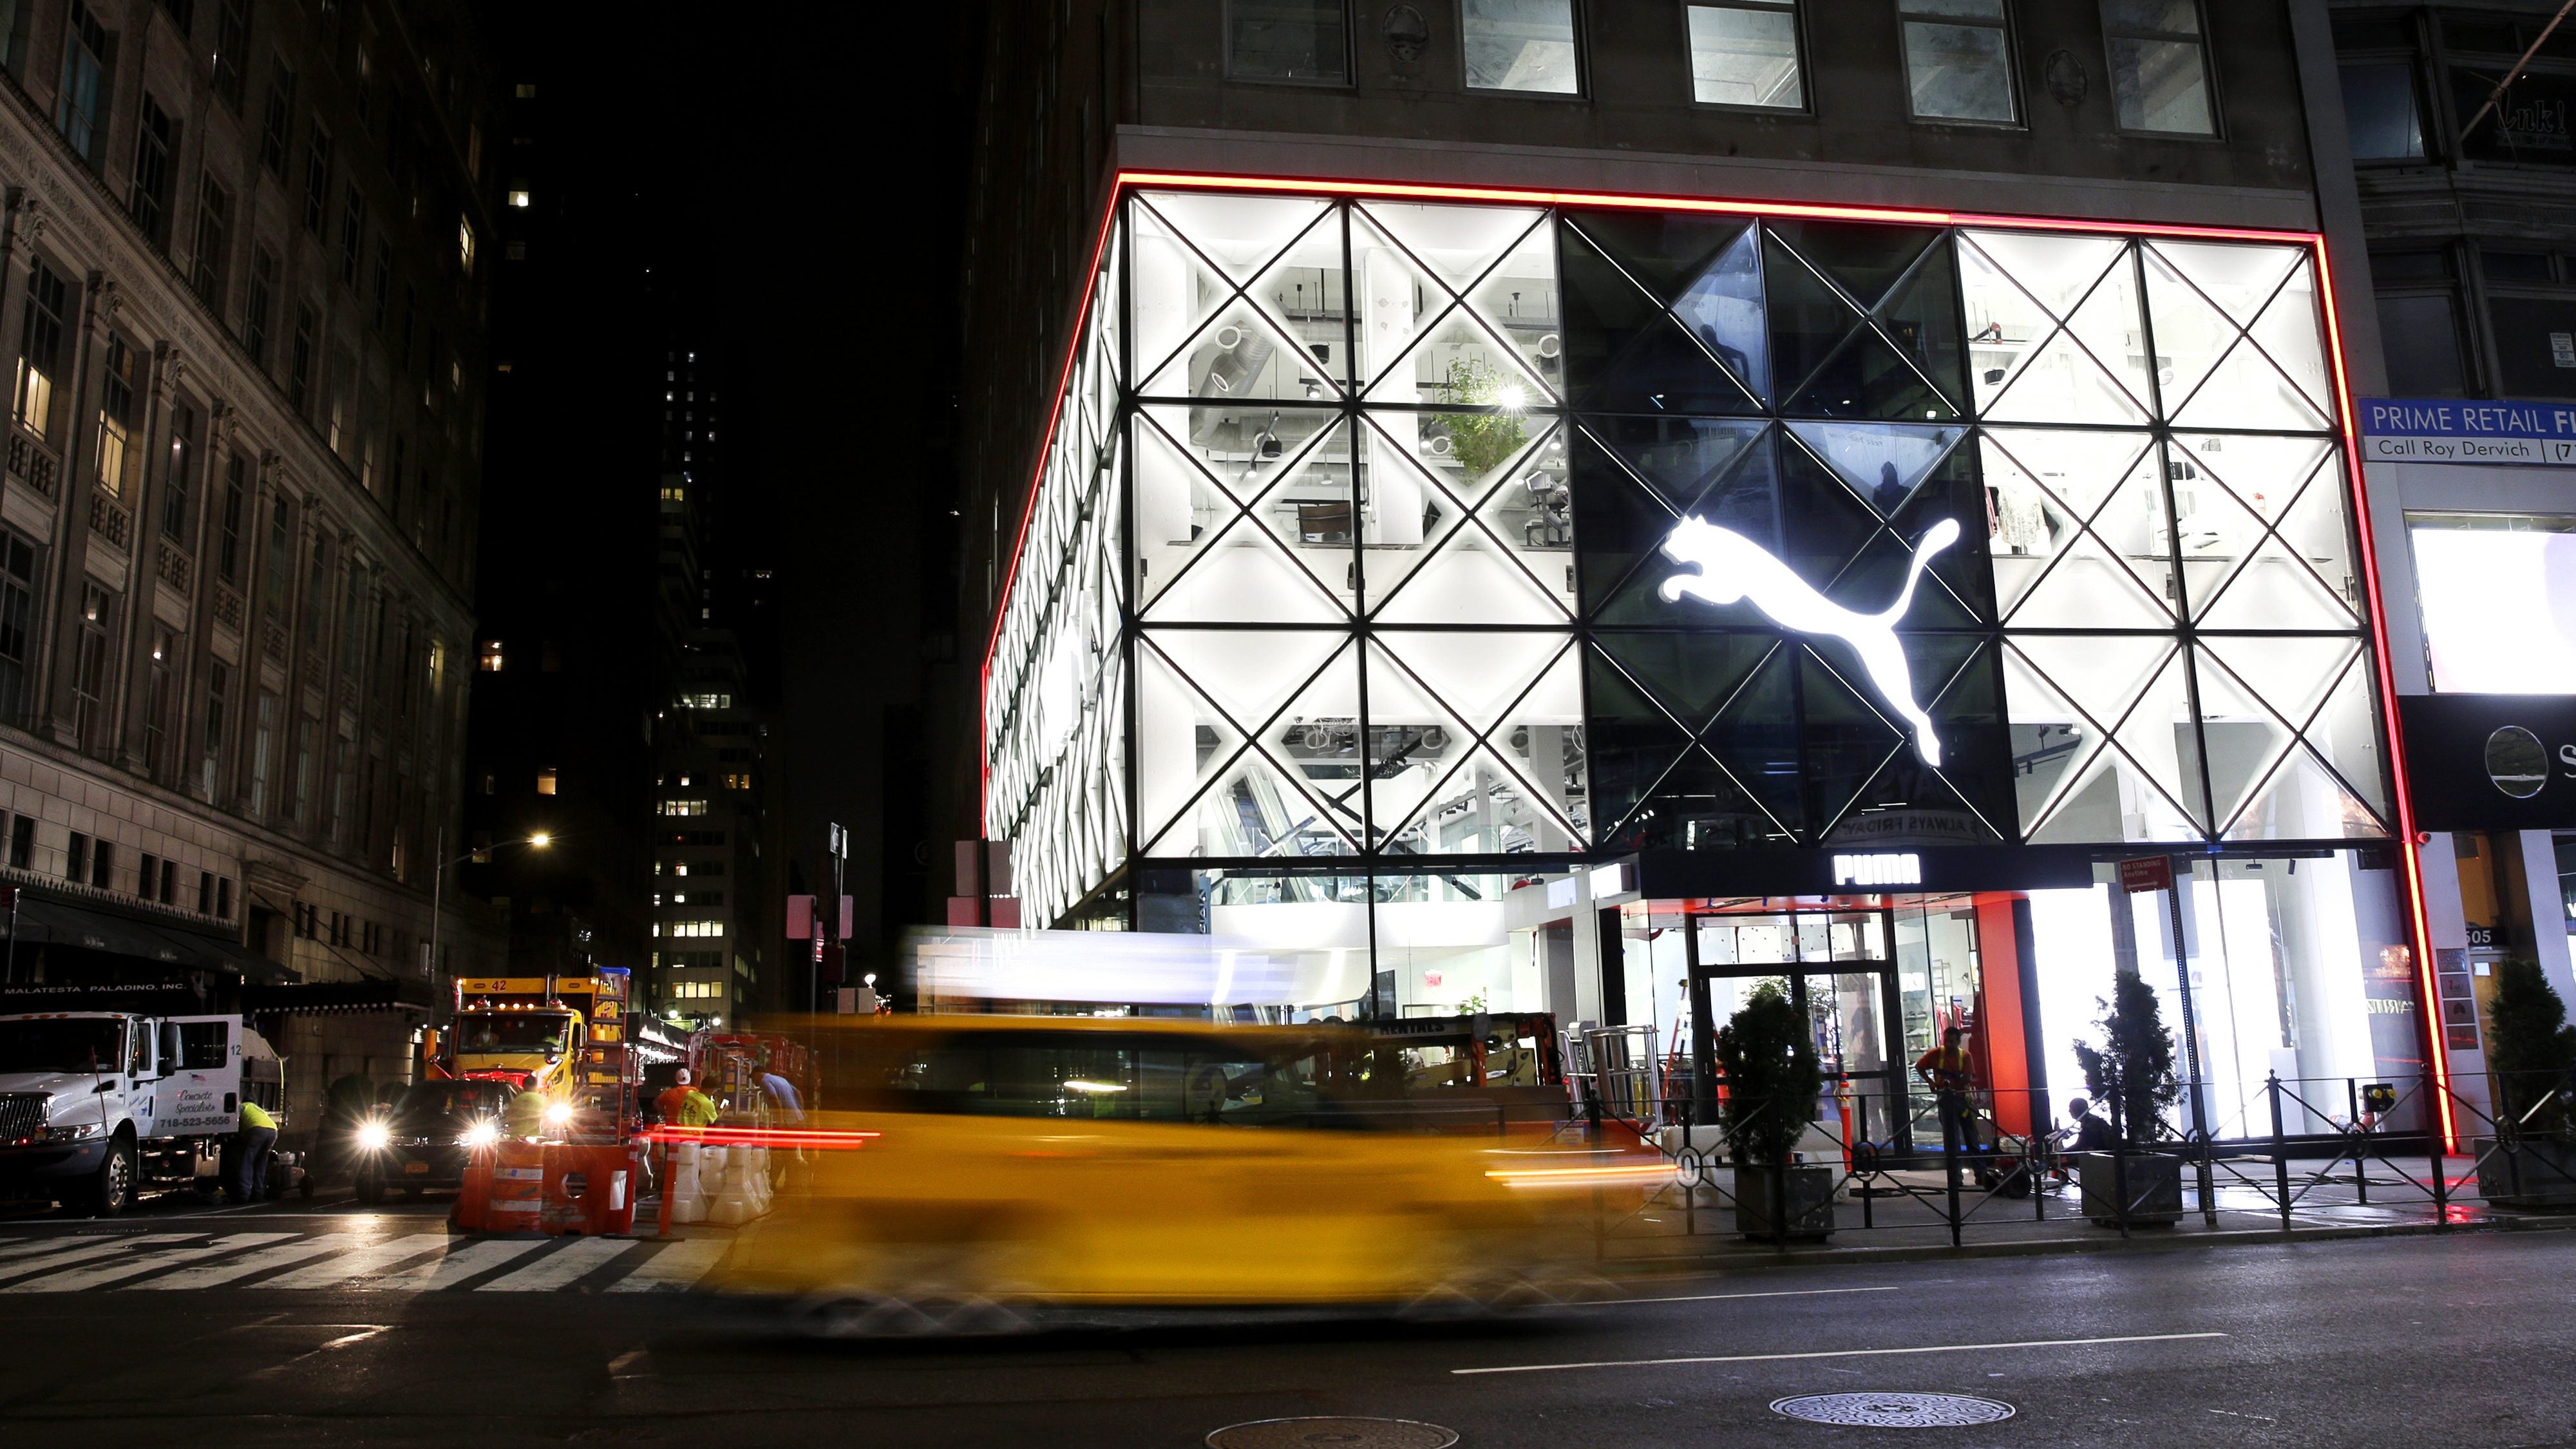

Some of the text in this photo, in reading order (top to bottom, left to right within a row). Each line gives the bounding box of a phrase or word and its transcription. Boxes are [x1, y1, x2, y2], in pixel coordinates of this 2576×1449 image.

[2372, 406, 2452, 430] PRIME
[2463, 408, 2546, 432] RETAIL
[2378, 440, 2415, 455] Call
[2423, 441, 2455, 459] Roy
[2463, 441, 2530, 457] Dervich
[1833, 853, 1921, 886] PUMA
[2132, 860, 2161, 869] STANDING
[491, 980, 506, 991] 42
[1379, 1022, 1444, 1036] RENTALS
[231, 1045, 242, 1056] 12
[180, 1090, 214, 1101] Concrete
[175, 1102, 216, 1115] Specialists
[160, 1116, 230, 1128] 718-523-5656
